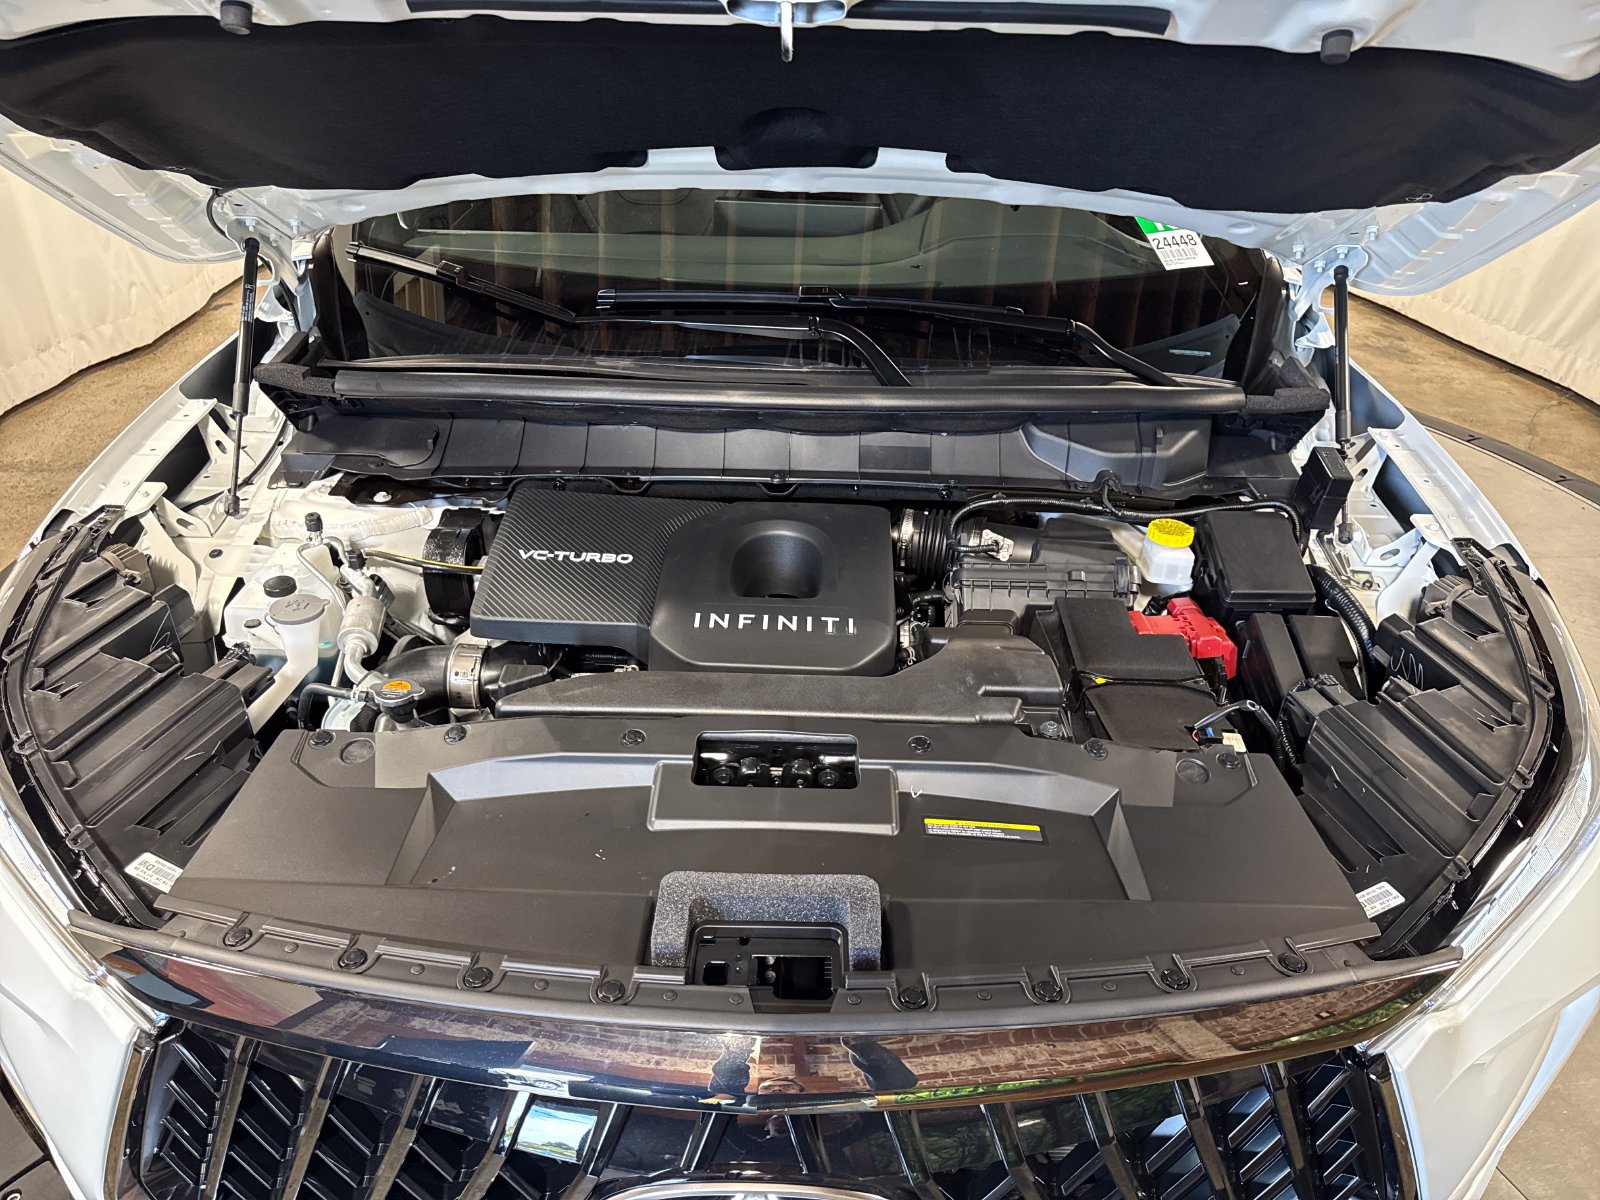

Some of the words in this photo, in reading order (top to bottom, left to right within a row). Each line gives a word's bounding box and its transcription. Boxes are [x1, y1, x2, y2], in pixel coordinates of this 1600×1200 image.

[1152, 234, 1197, 250] 24448
[518, 549, 634, 564] VC-TURBO
[693, 612, 855, 635] INFINITI
